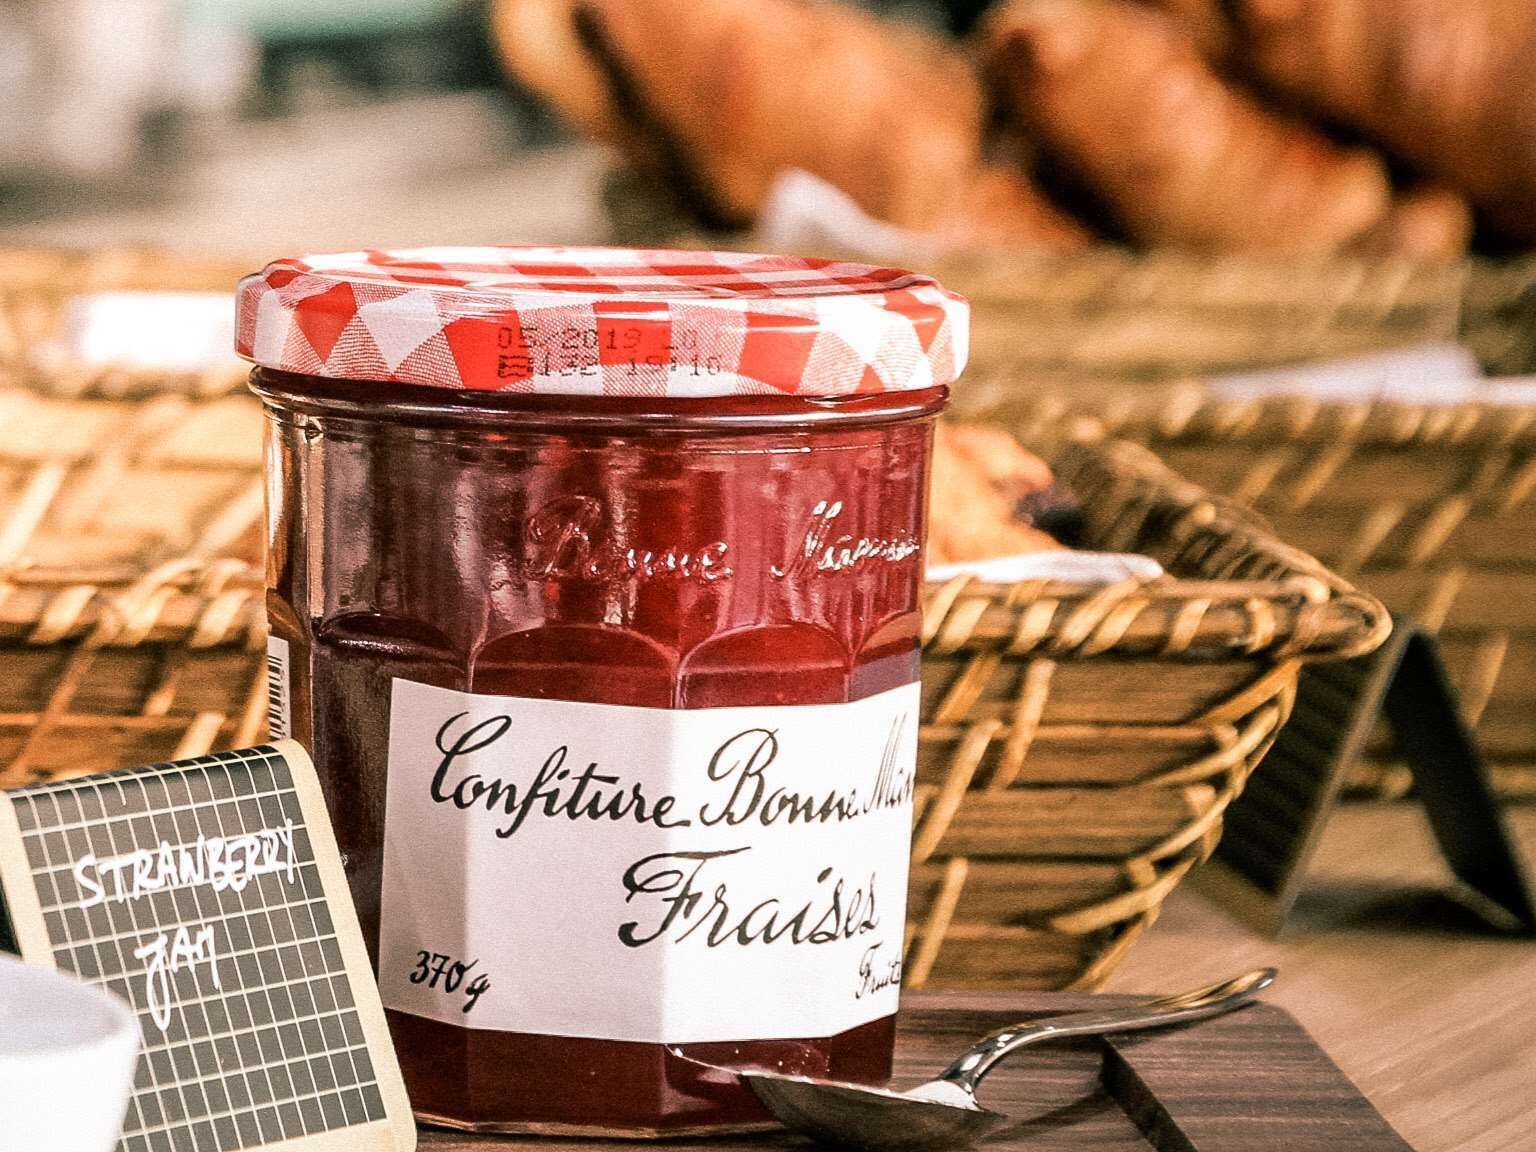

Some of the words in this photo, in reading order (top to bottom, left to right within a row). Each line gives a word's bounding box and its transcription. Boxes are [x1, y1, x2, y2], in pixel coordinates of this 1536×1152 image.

[430, 710, 690, 838] Confiture
[699, 727, 859, 827] Bonne
[73, 818, 295, 909] STRAWBERRY
[618, 846, 881, 948] Fraises
[134, 924, 221, 1032] JAM
